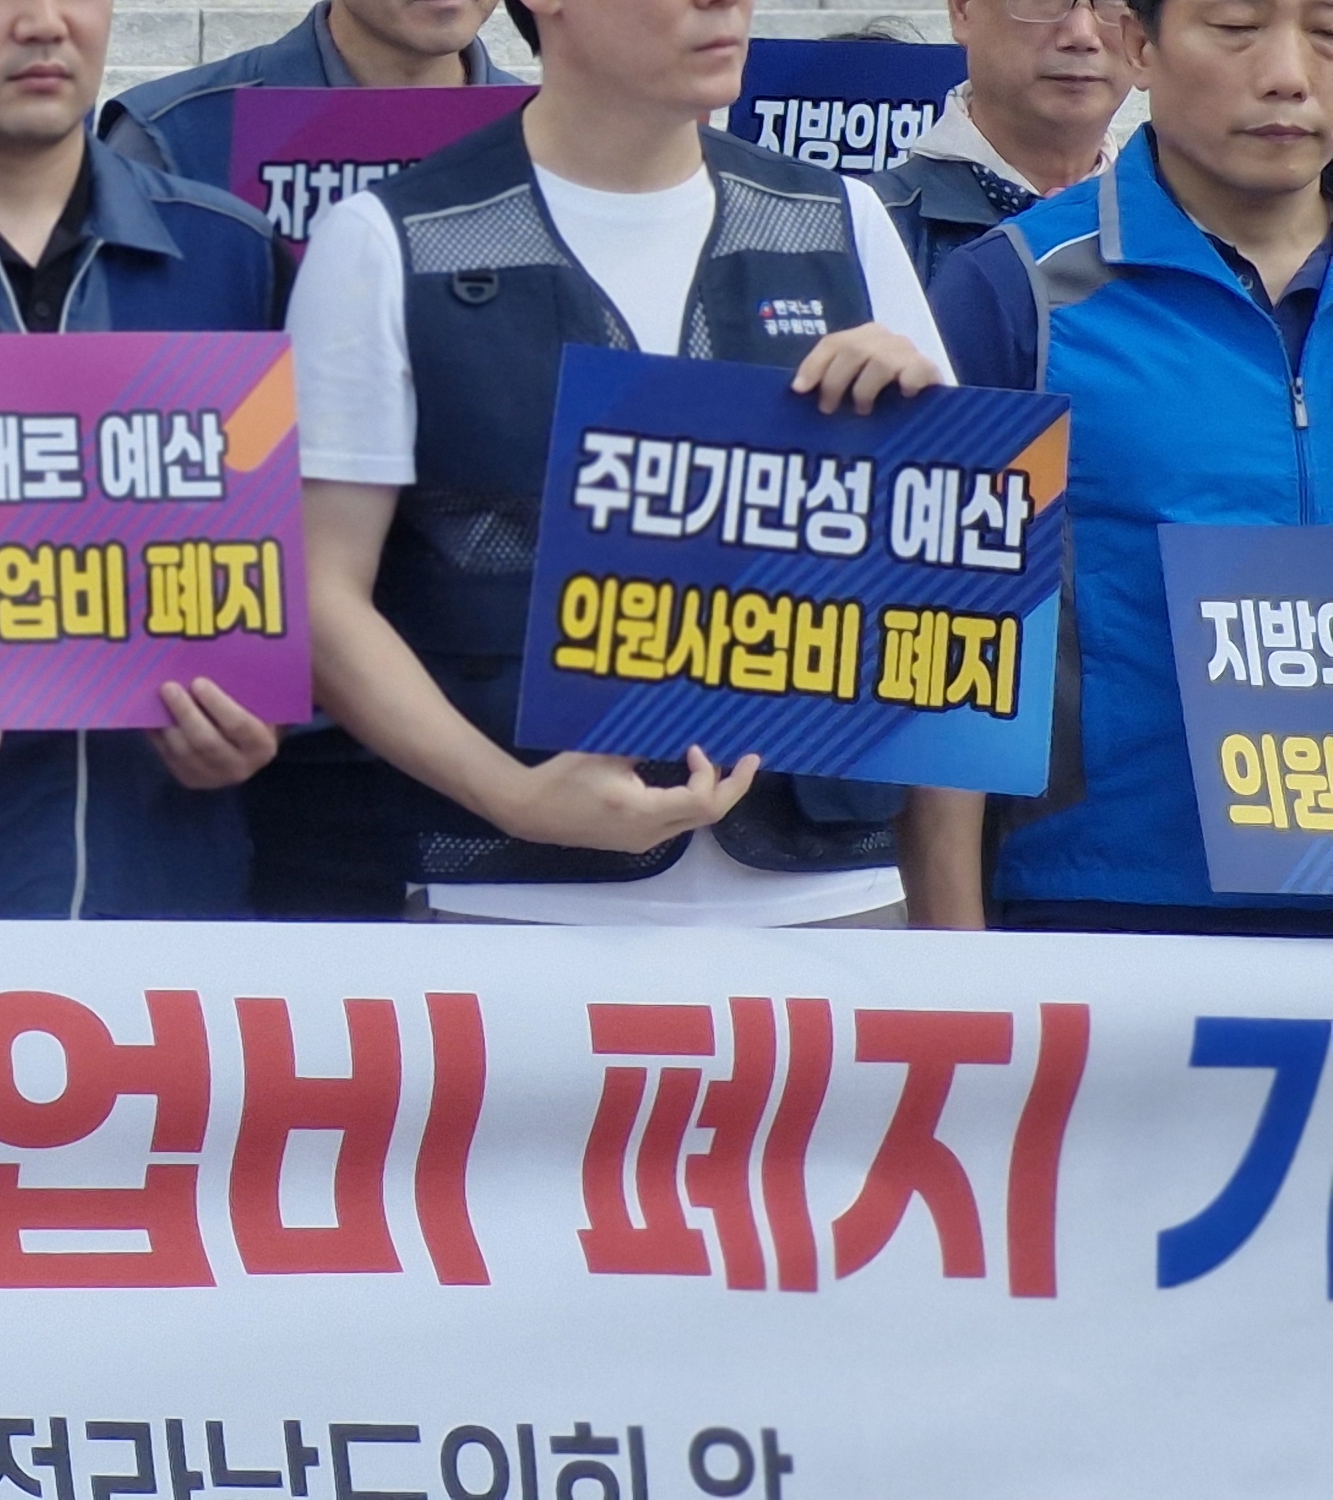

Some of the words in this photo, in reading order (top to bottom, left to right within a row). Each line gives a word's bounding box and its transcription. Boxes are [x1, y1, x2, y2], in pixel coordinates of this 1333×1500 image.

[99, 412, 225, 499] 예산
[574, 432, 873, 556] 주민기만성
[890, 466, 1030, 572] 예산
[145, 540, 282, 637] 폐지
[555, 576, 861, 698] 의원사업비
[877, 609, 1017, 715] 폐지
[576, 996, 1090, 1299] 폐지
